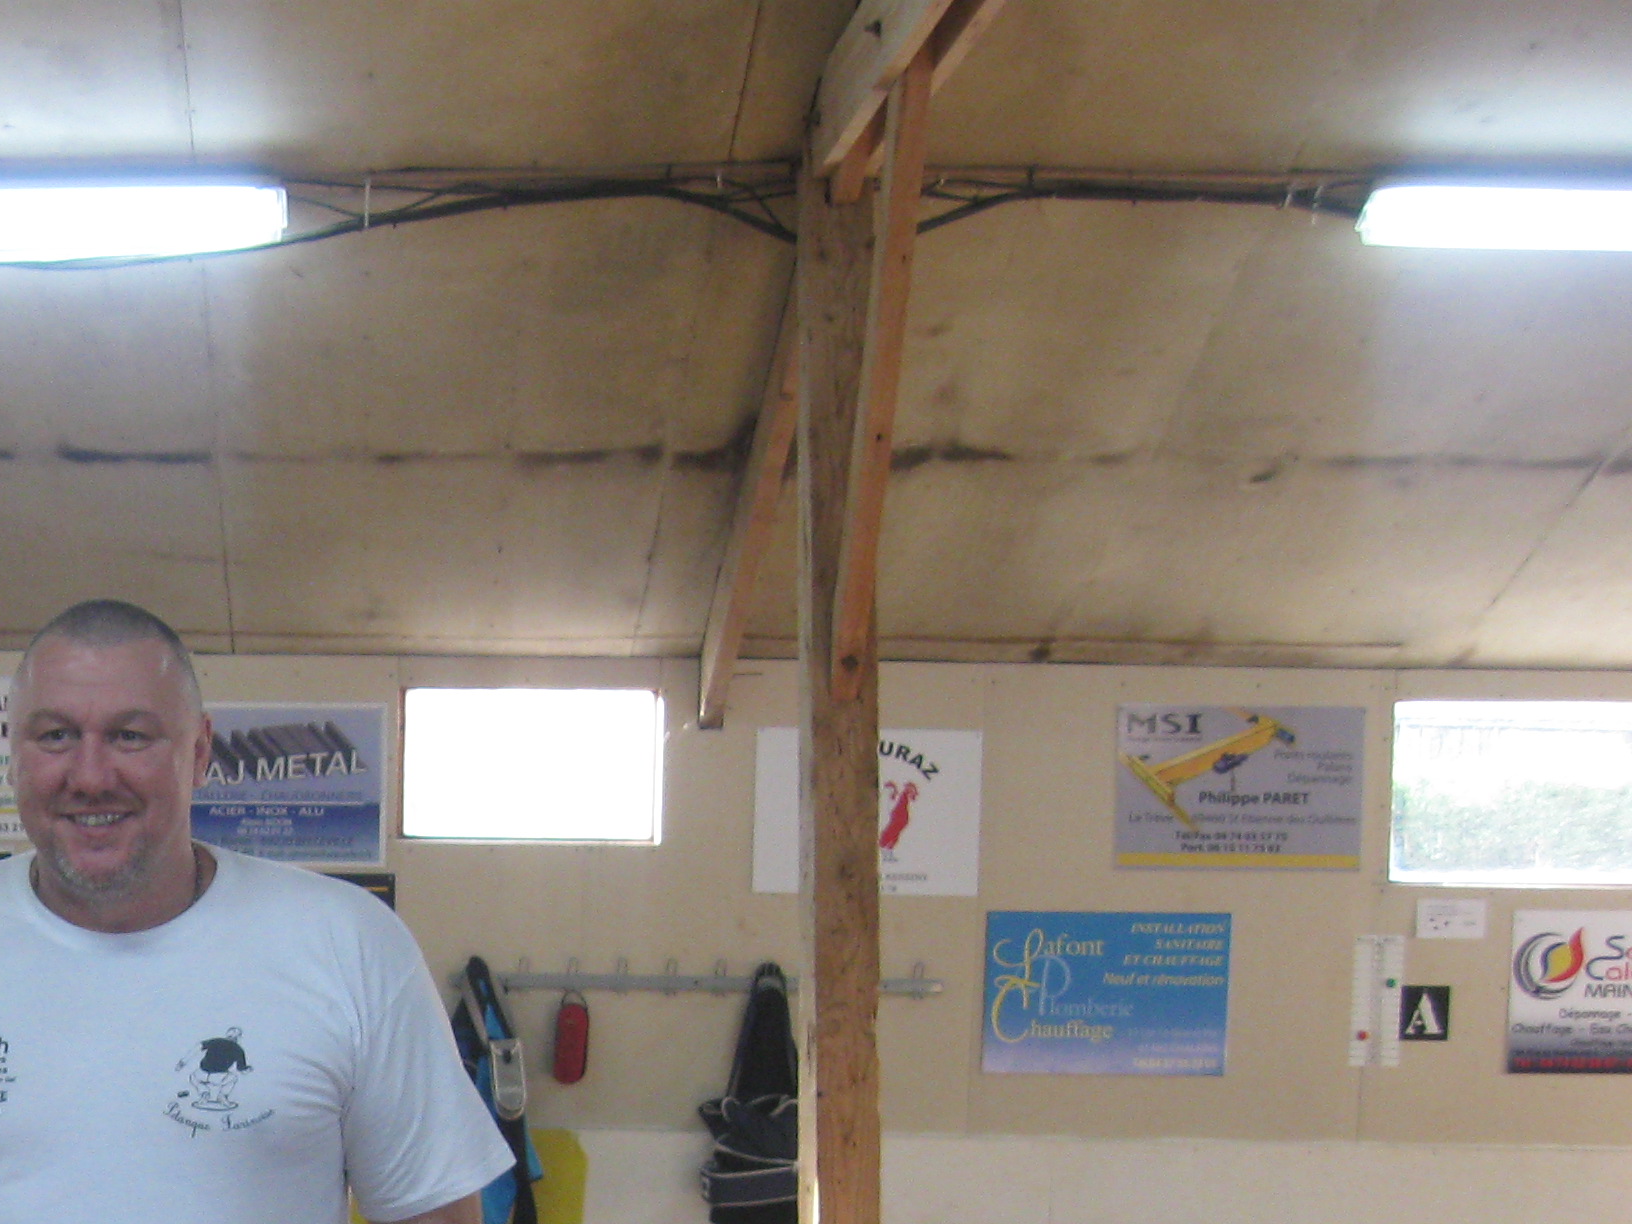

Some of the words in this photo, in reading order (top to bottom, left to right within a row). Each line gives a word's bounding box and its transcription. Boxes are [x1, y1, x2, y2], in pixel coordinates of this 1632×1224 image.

[1127, 713, 1203, 734] MSI
[256, 750, 367, 781] METAL
[1198, 792, 1260, 806] Philippe
[1263, 793, 1310, 805] PARET
[1405, 990, 1446, 1036] A
